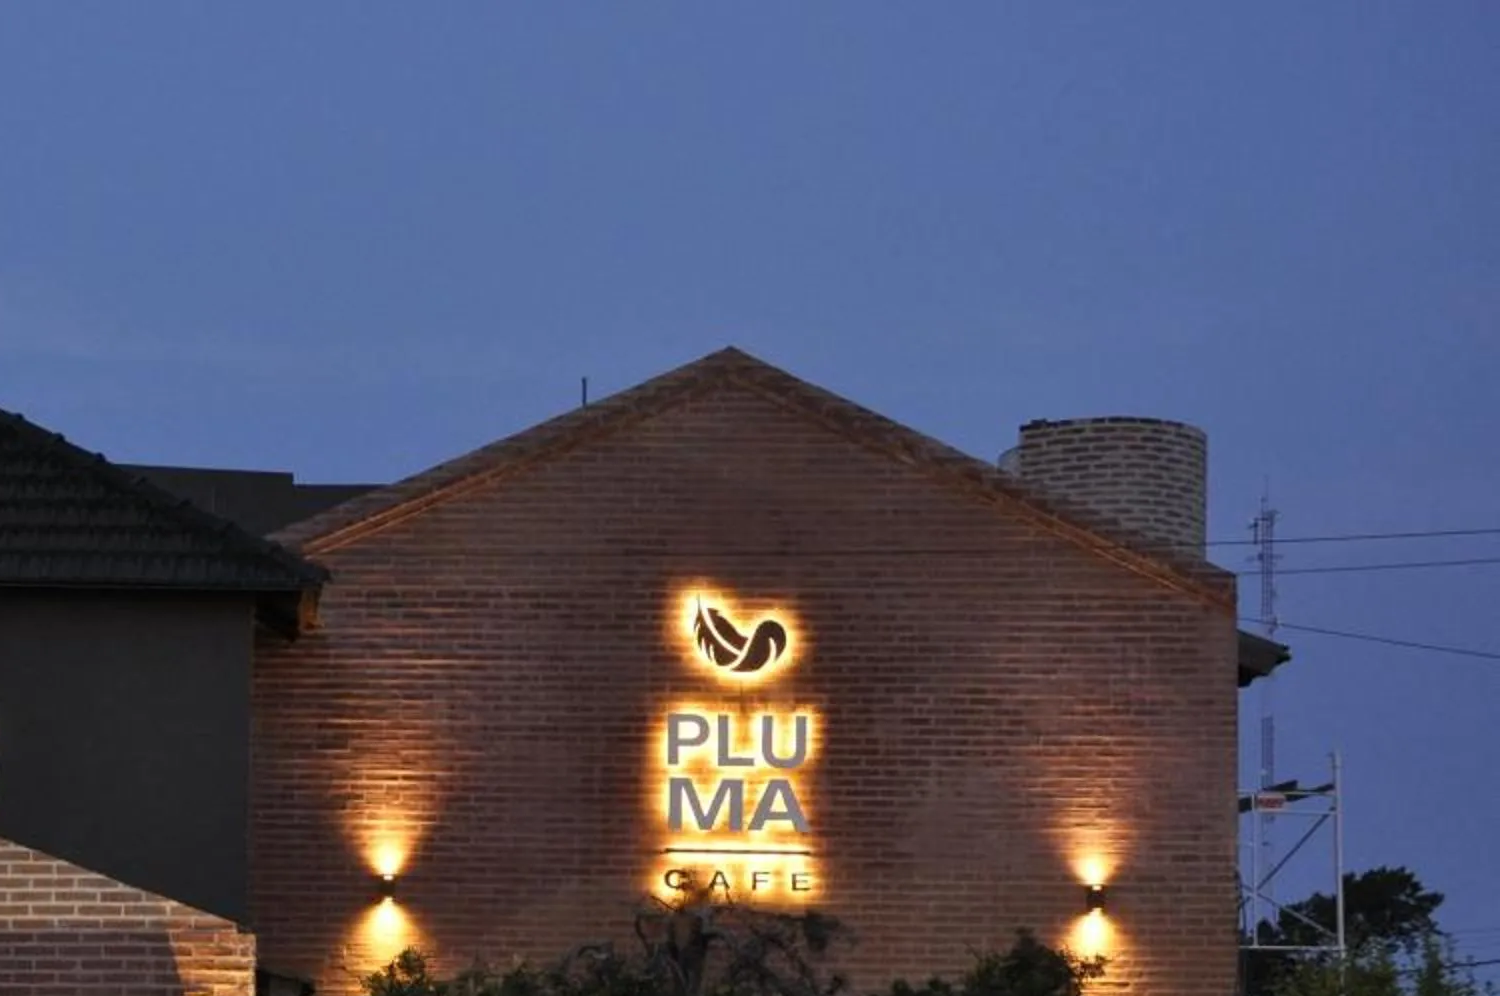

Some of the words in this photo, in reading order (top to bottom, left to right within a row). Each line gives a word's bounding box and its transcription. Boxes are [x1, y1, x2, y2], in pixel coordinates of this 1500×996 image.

[666, 713, 808, 769] PLU
[666, 777, 811, 833] MA
[663, 869, 812, 892] CAFE
